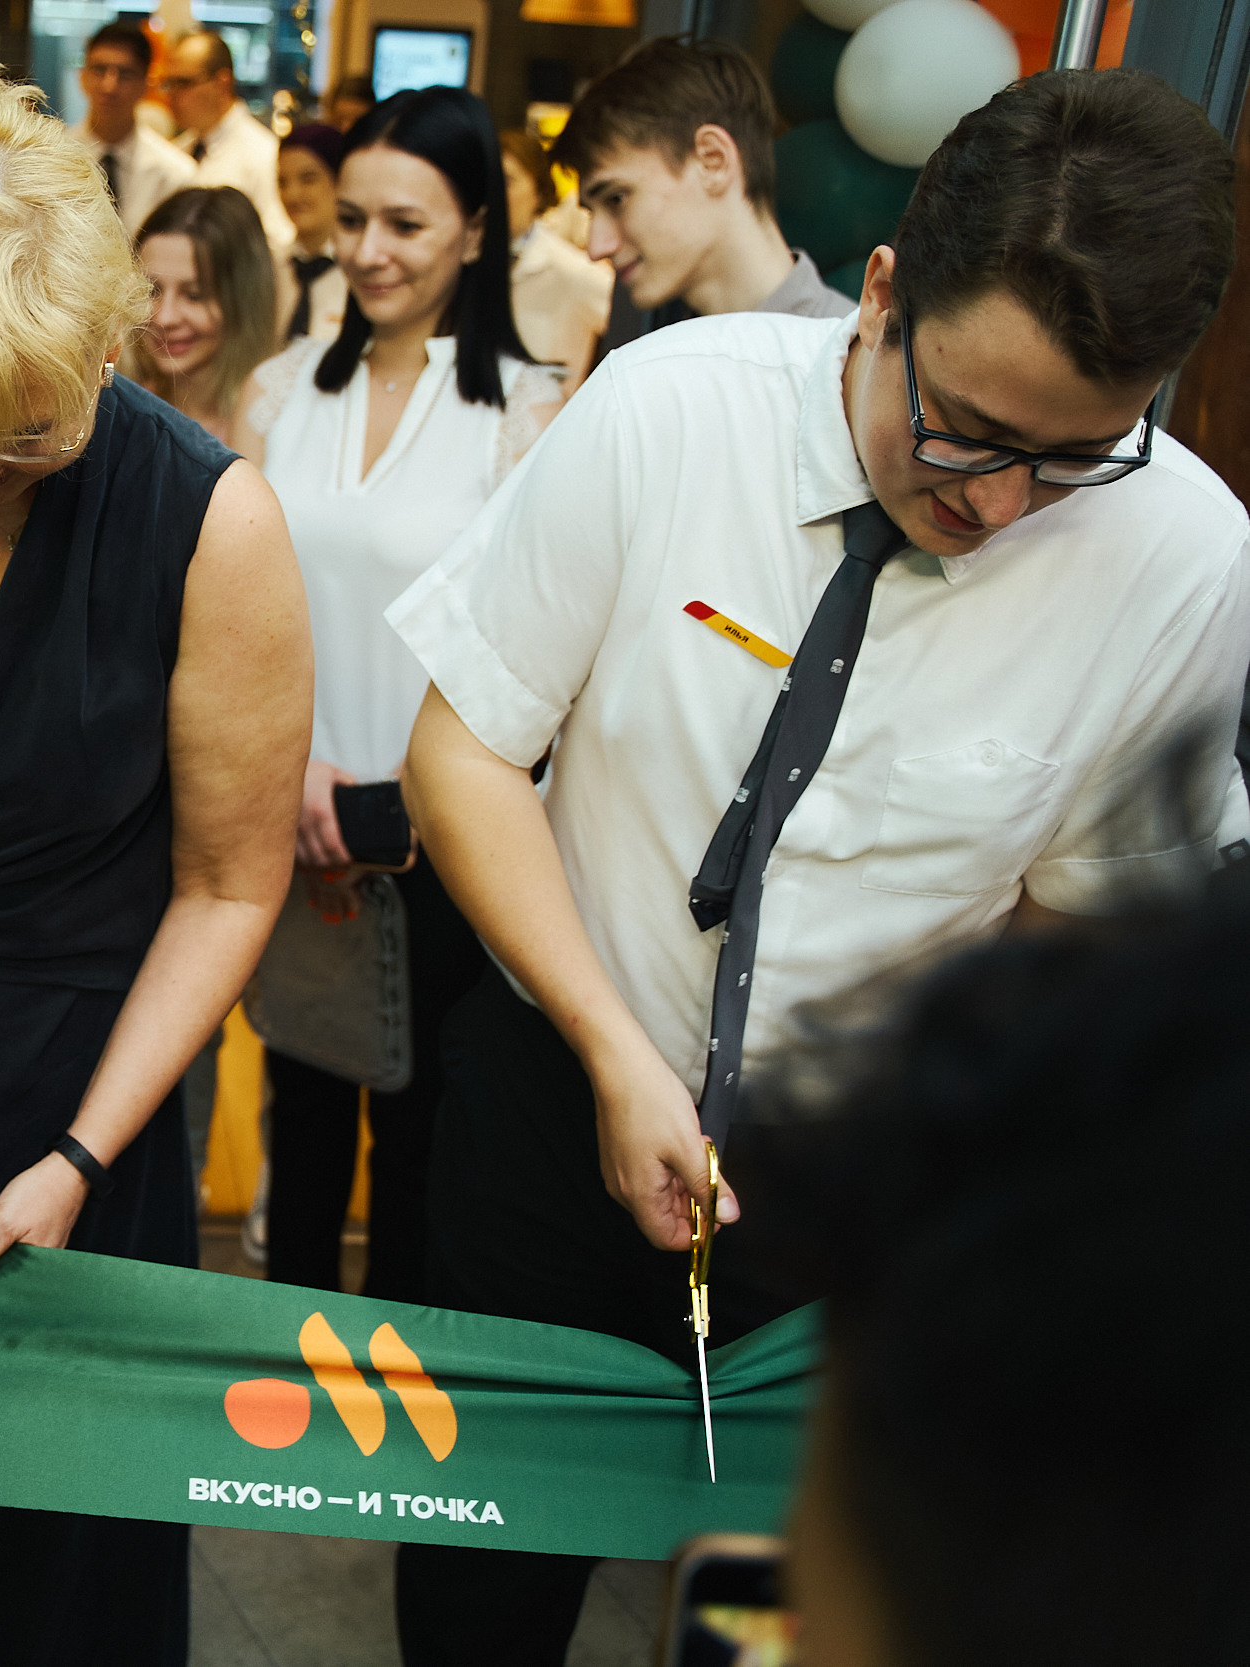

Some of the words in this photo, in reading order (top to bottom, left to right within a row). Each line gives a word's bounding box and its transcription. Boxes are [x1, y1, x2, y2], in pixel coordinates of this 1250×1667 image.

[724, 625, 749, 643] ИЛЬЯ
[188, 1477, 322, 1511] ВКУСНО
[358, 1491, 382, 1515] И
[390, 1493, 505, 1525] ТОЧКА
